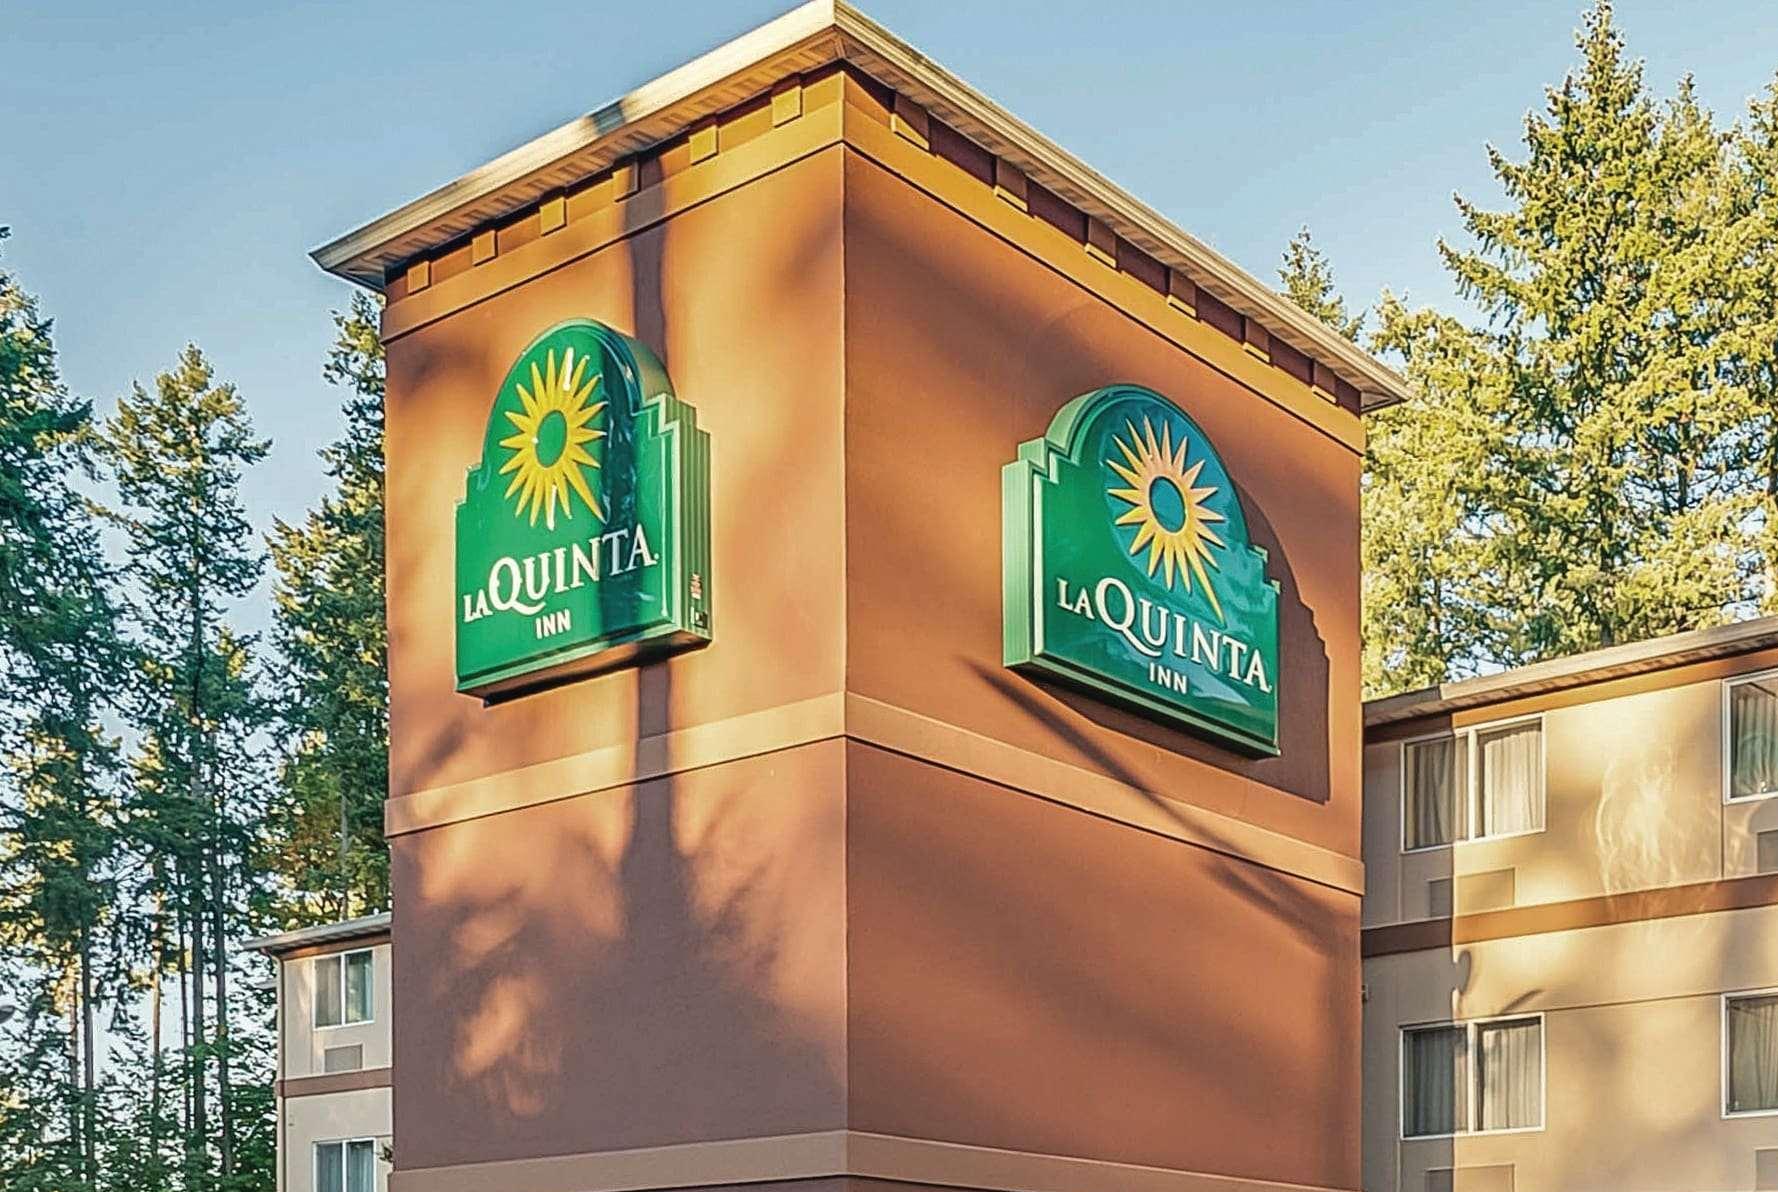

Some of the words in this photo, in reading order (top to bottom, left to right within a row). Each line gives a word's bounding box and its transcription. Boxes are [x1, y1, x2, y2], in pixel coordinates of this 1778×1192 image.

[463, 589, 493, 622] LA
[535, 608, 571, 639] INN
[1056, 577, 1095, 620] LA
[1095, 577, 1271, 693] QUINTA
[1149, 661, 1187, 694] INN
